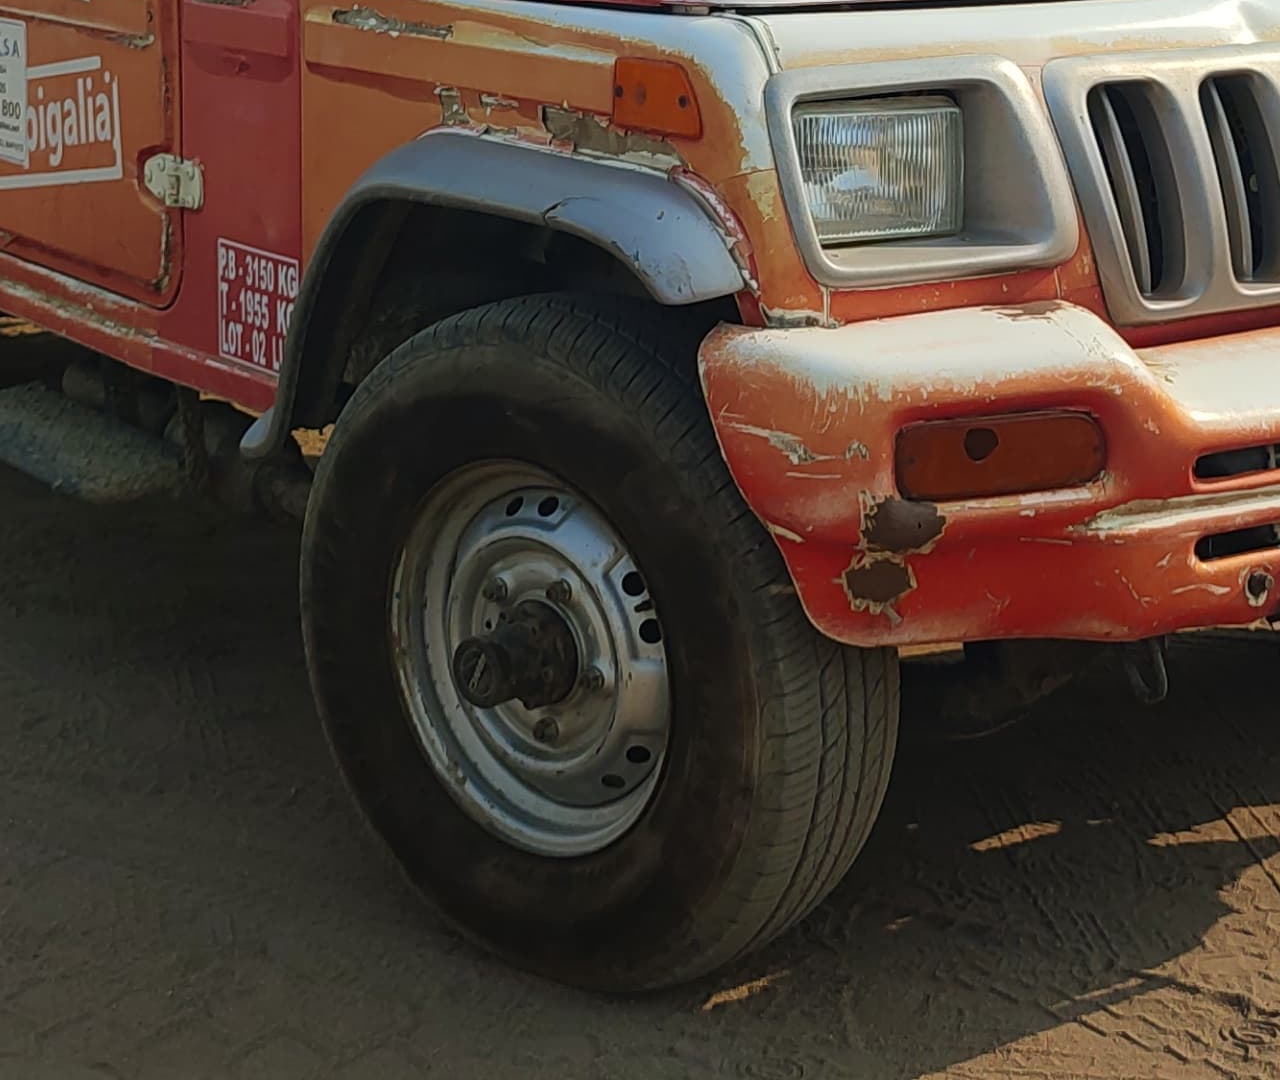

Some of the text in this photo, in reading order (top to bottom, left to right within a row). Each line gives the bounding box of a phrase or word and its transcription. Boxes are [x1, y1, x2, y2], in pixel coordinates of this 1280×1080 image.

[245, 256, 274, 293] 3150
[278, 263, 299, 299] KG
[239, 288, 270, 330] 1955
